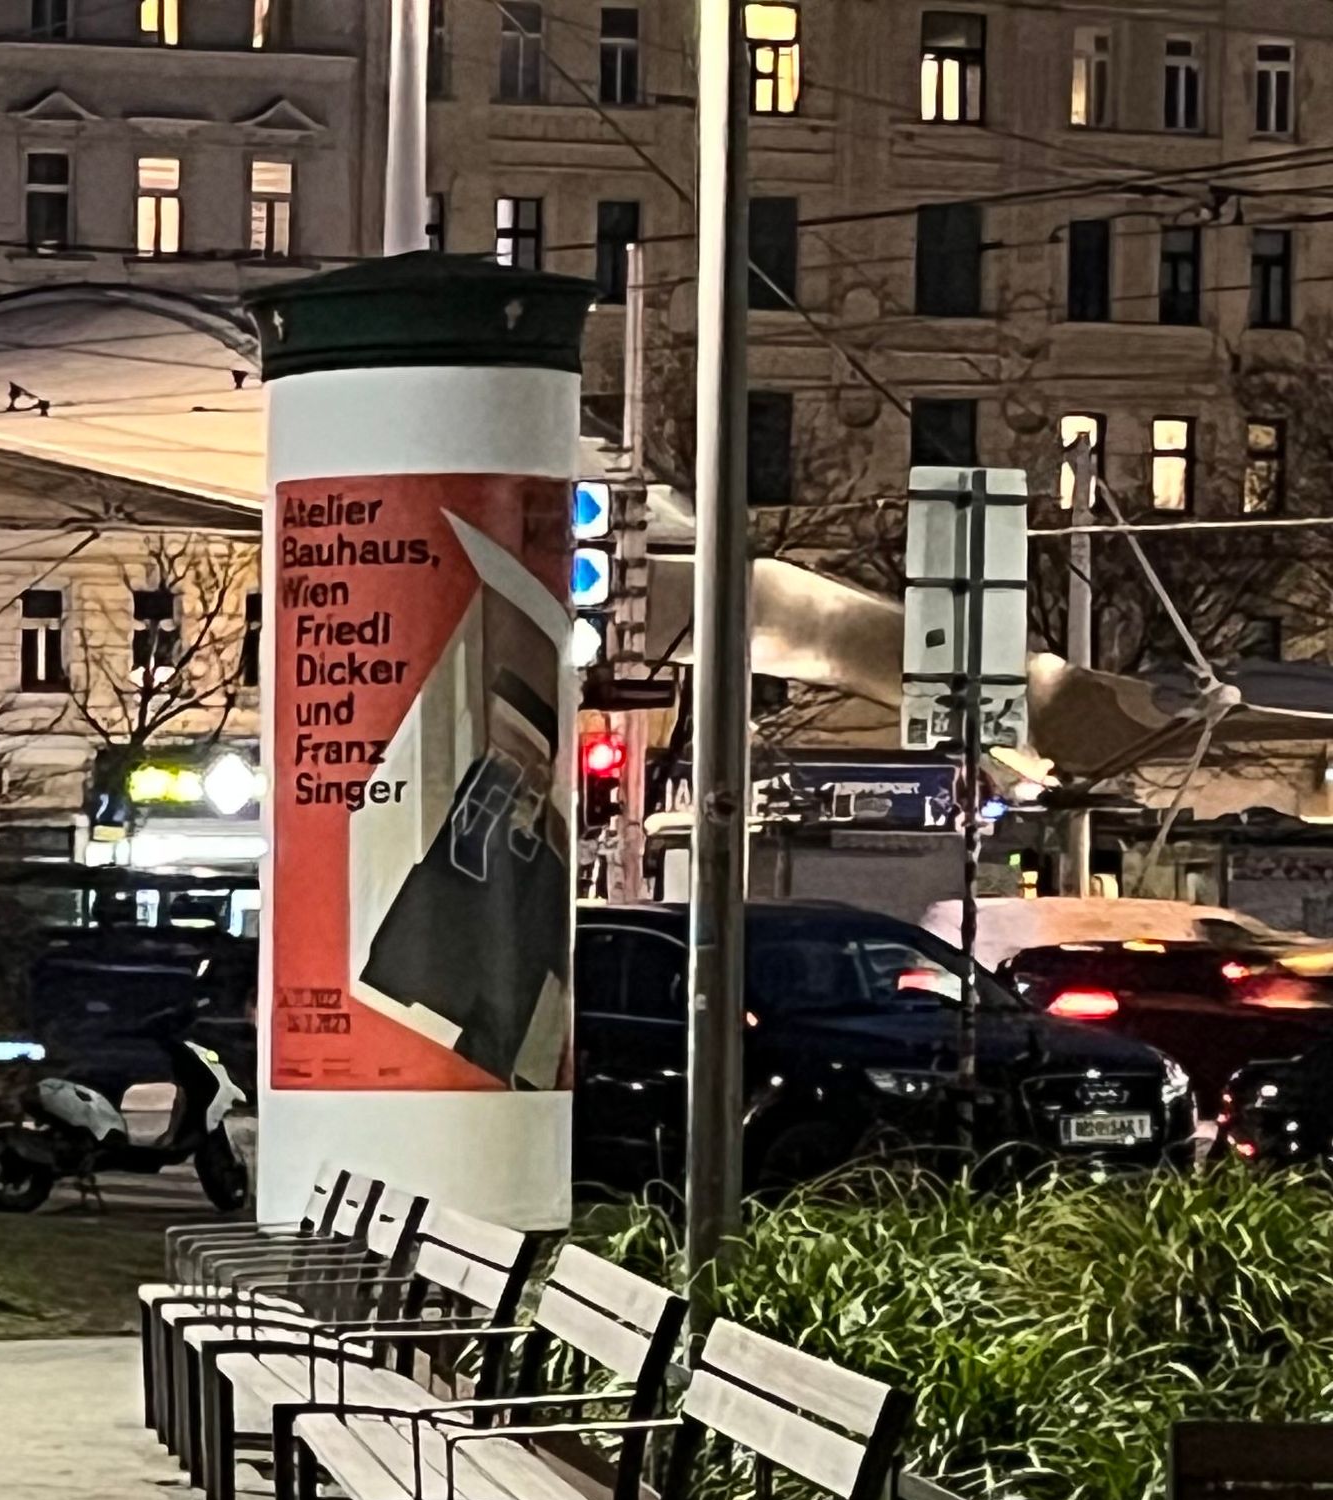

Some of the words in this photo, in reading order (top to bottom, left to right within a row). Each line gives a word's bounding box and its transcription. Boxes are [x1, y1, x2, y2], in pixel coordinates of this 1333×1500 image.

[282, 495, 383, 529] Atelier
[282, 535, 442, 570] Bauhaus,
[282, 578, 349, 611] Wien
[295, 612, 391, 647] Friedl
[295, 651, 410, 688] Dicker
[295, 690, 355, 727] und
[295, 733, 388, 767] Franz
[295, 771, 408, 812] Singer
